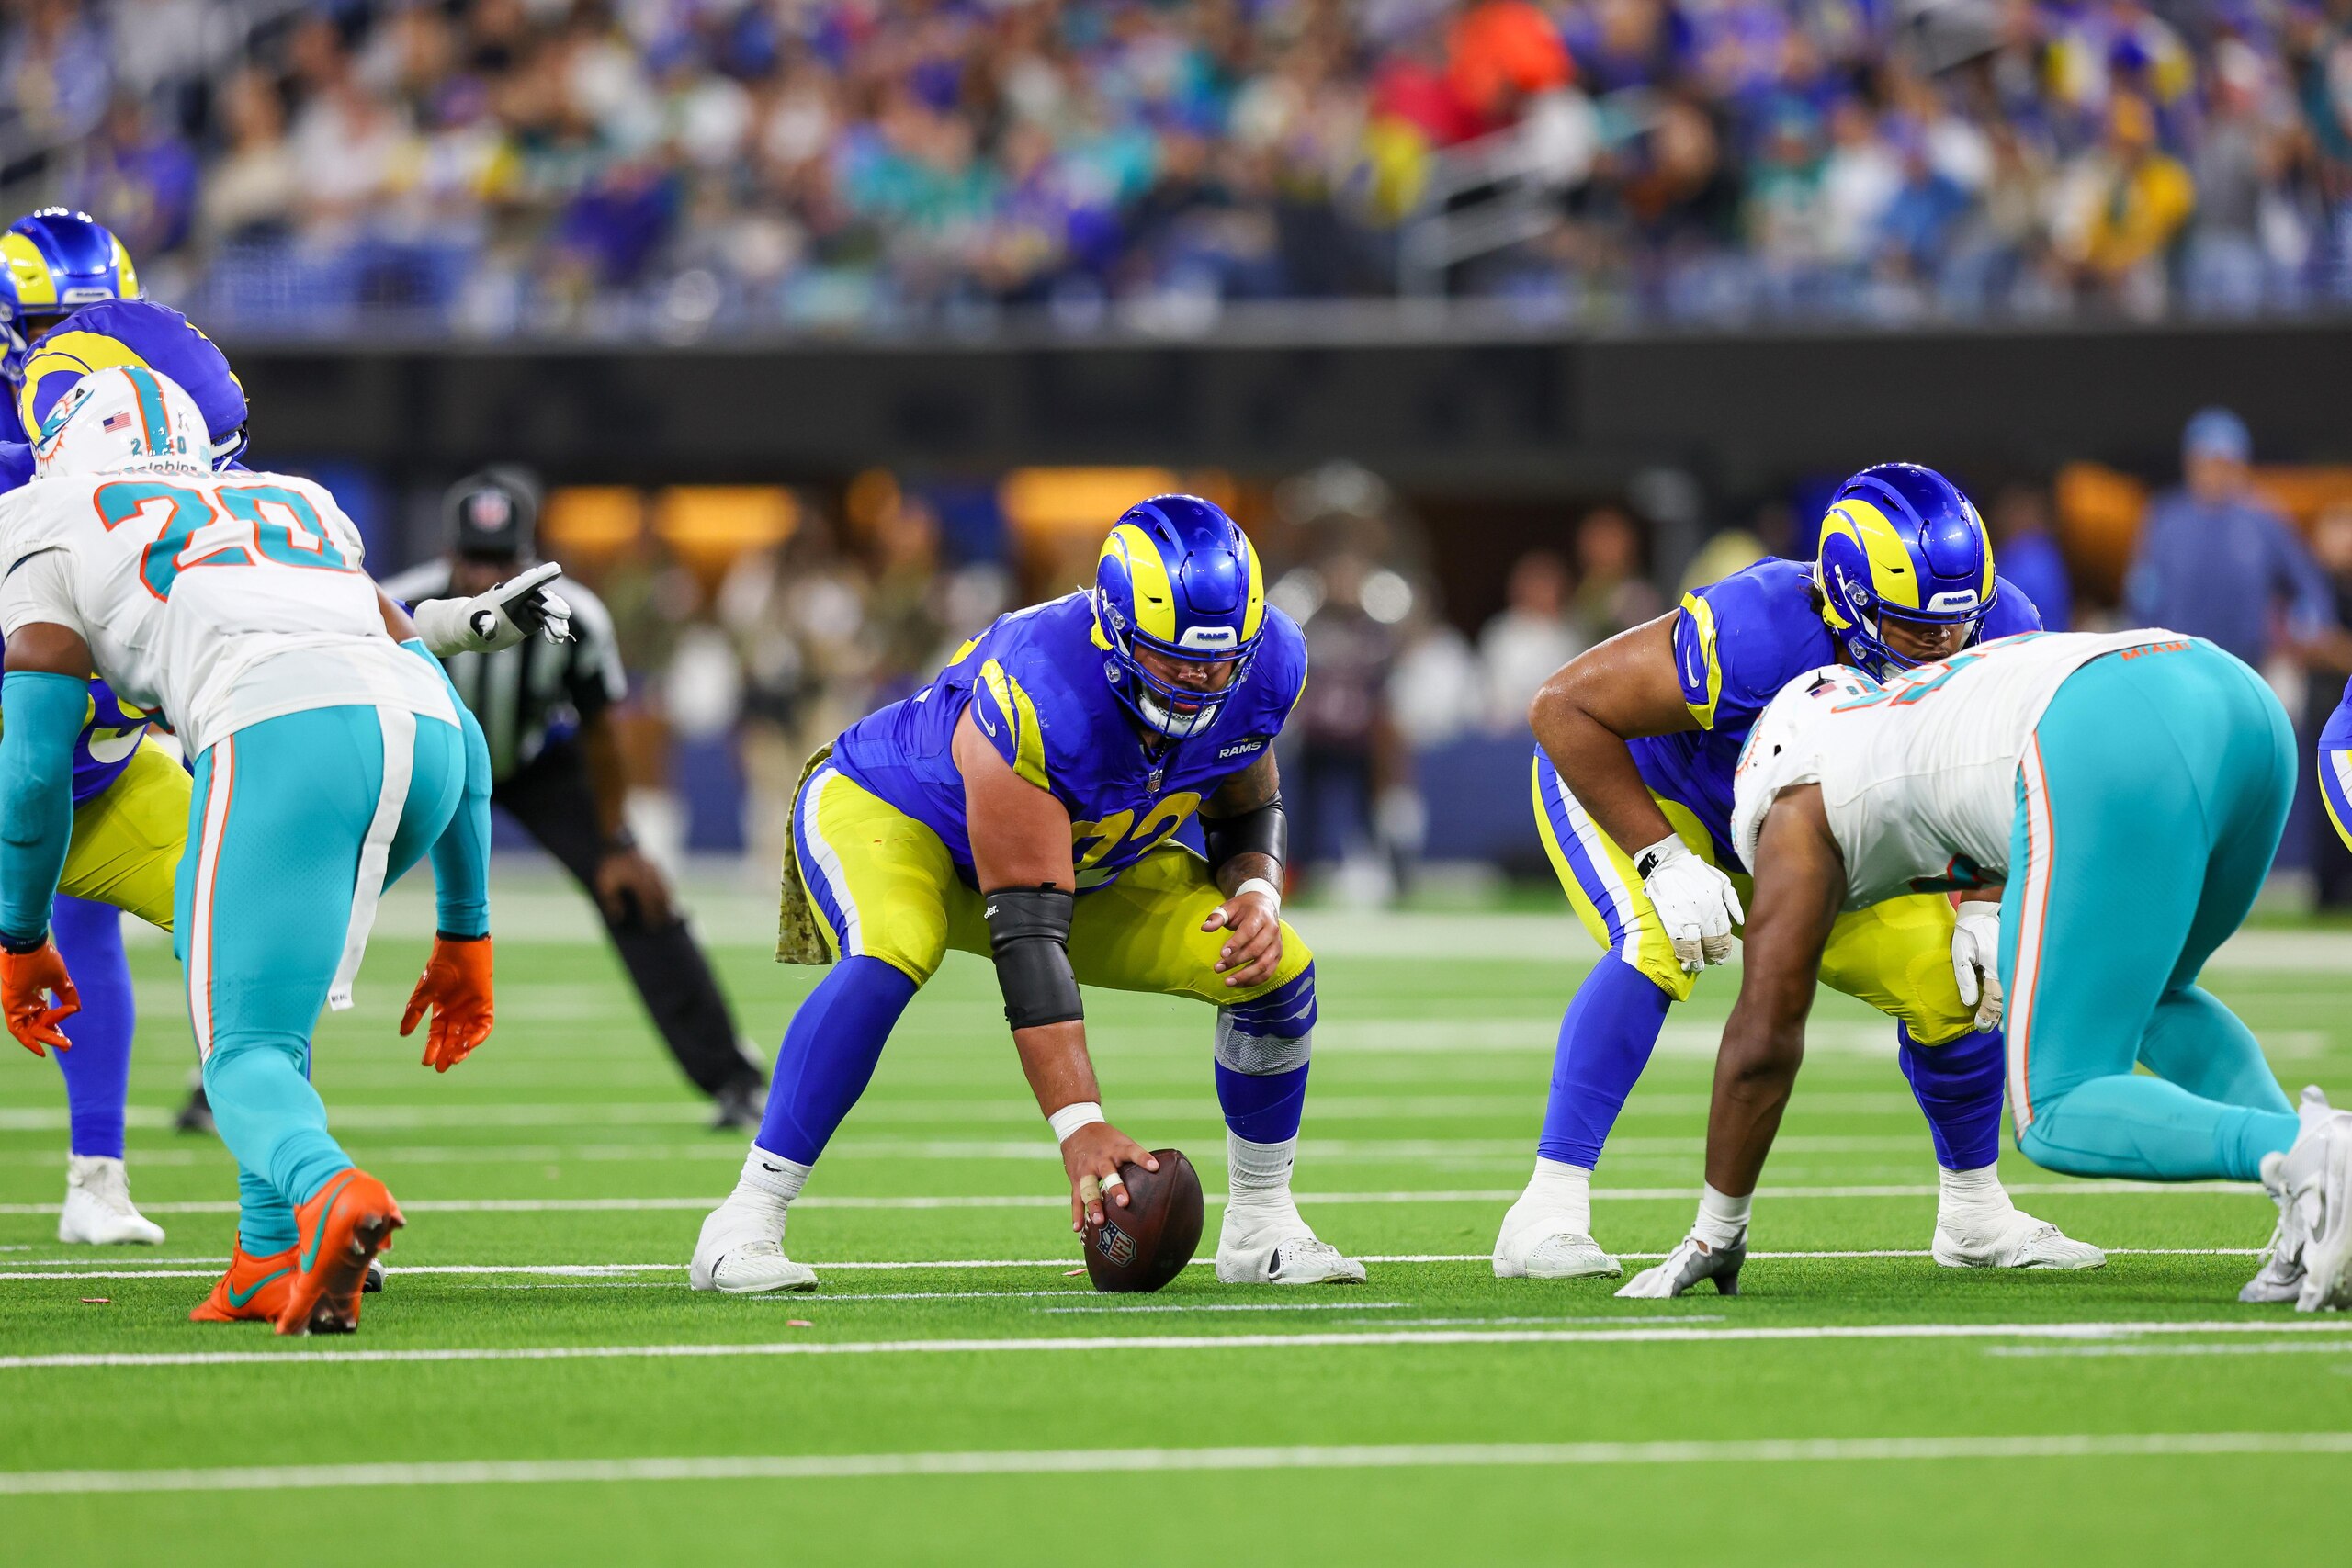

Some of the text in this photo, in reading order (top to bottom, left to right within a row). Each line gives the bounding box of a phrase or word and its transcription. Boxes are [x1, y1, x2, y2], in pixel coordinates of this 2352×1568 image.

[93, 480, 360, 604] 20
[1197, 632, 1229, 640] RAMS
[2120, 641, 2192, 661] MIAMI
[1219, 741, 1261, 759] RAMS
[1109, 1235, 1132, 1264] NFL
